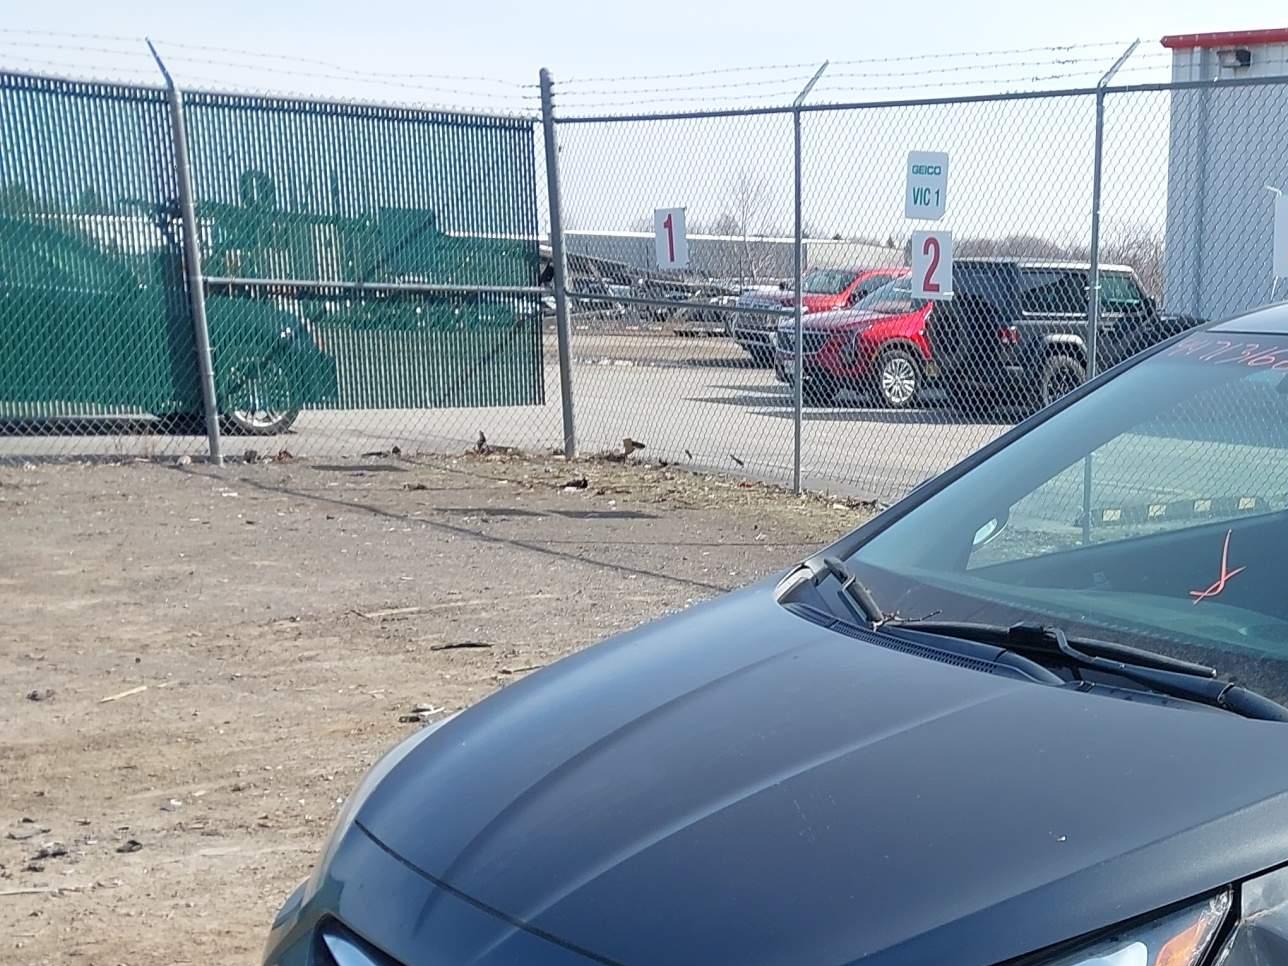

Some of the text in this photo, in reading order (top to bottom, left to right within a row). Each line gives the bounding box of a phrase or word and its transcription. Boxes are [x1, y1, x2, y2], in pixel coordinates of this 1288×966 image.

[911, 165, 942, 176] GEICO
[912, 186, 941, 207] VIC 1
[663, 213, 676, 263] 1
[922, 236, 941, 293] 2
